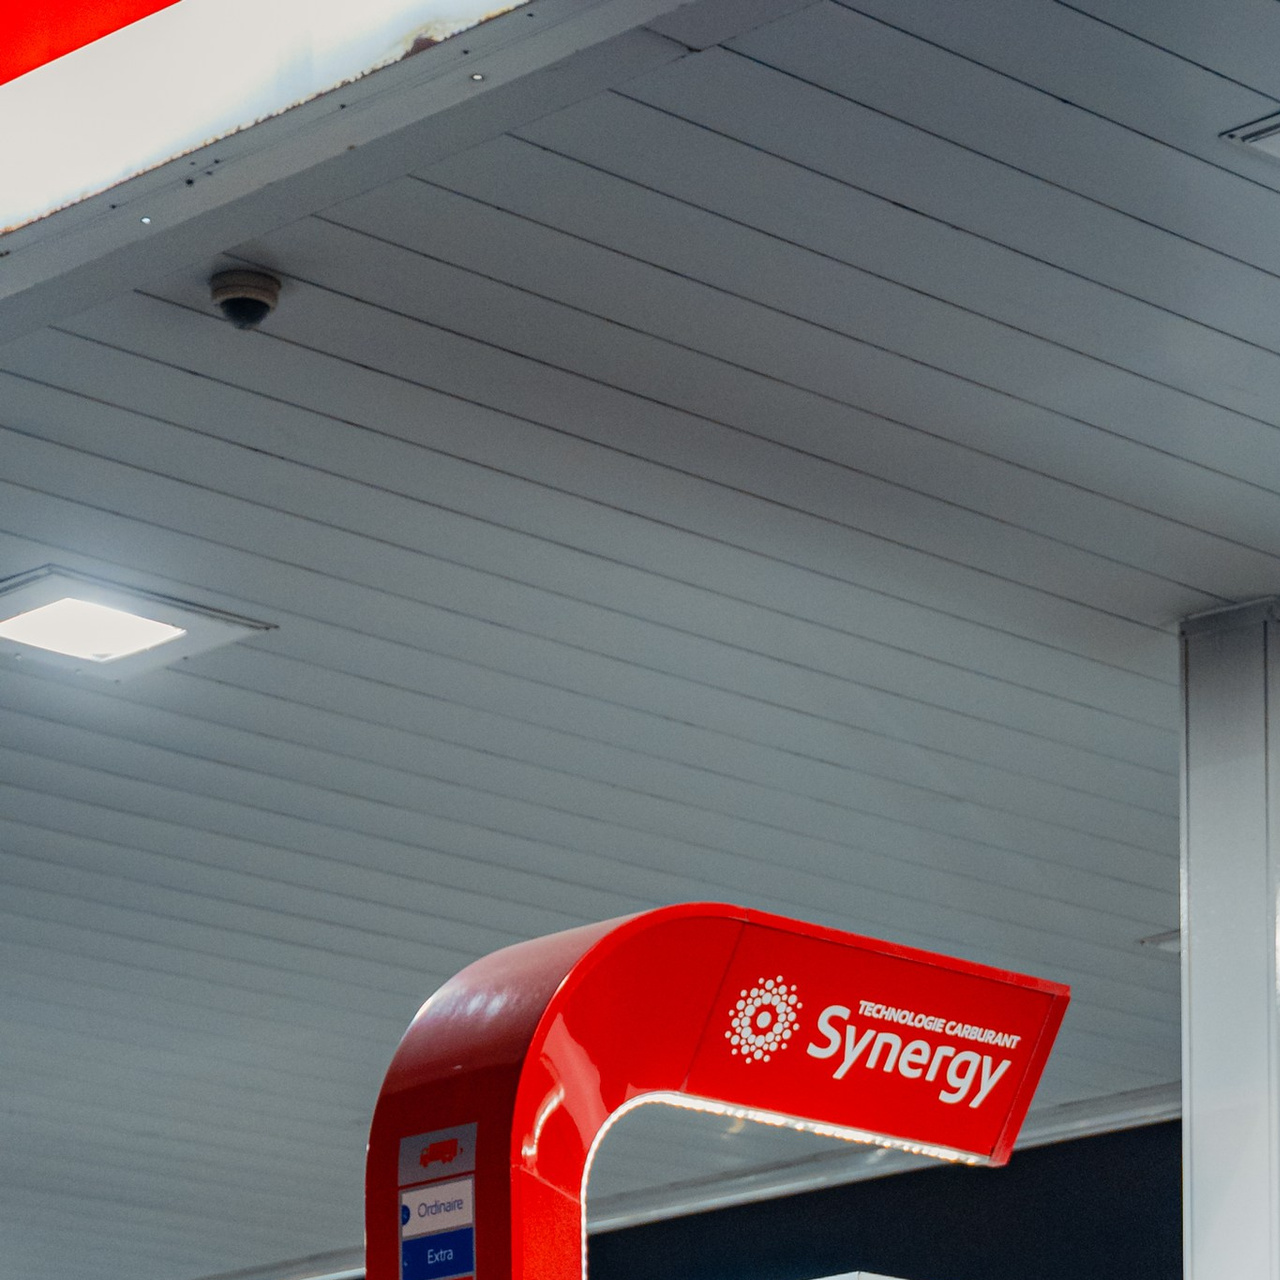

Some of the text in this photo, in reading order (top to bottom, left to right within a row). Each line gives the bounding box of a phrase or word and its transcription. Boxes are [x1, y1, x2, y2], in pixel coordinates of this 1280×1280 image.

[858, 1000, 1022, 1049] TECHNOLOGIE CARBURANT
[806, 1005, 1012, 1109] Synergy
[417, 1198, 464, 1218] Ordinaire
[427, 1249, 454, 1265] Extra
